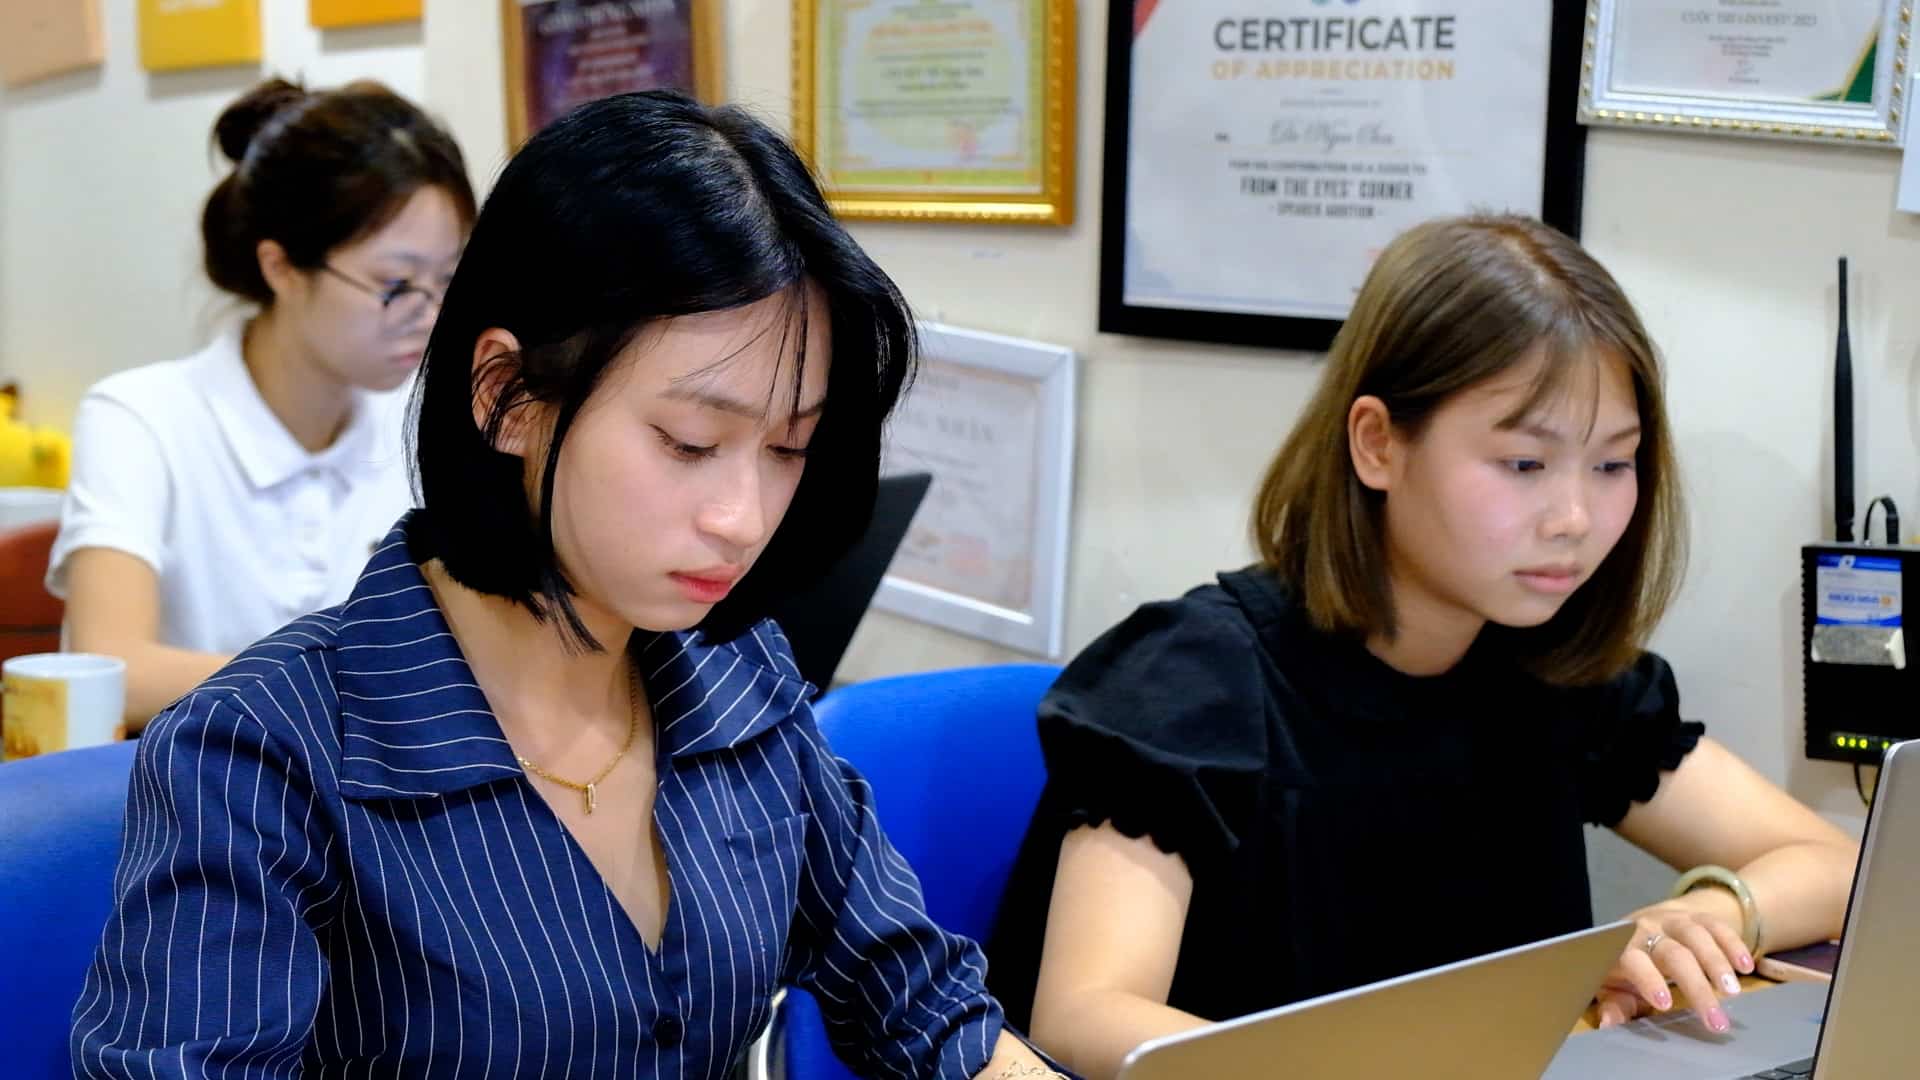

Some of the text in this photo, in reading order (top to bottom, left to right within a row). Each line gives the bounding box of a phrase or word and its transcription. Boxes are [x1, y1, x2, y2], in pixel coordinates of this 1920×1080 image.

[1213, 15, 1456, 52] CERTIFICATE
[1211, 58, 1455, 81] OF APPRECIATION
[1240, 176, 1277, 195] FROM
[1284, 177, 1309, 197] THE
[1359, 180, 1414, 200] CORNER
